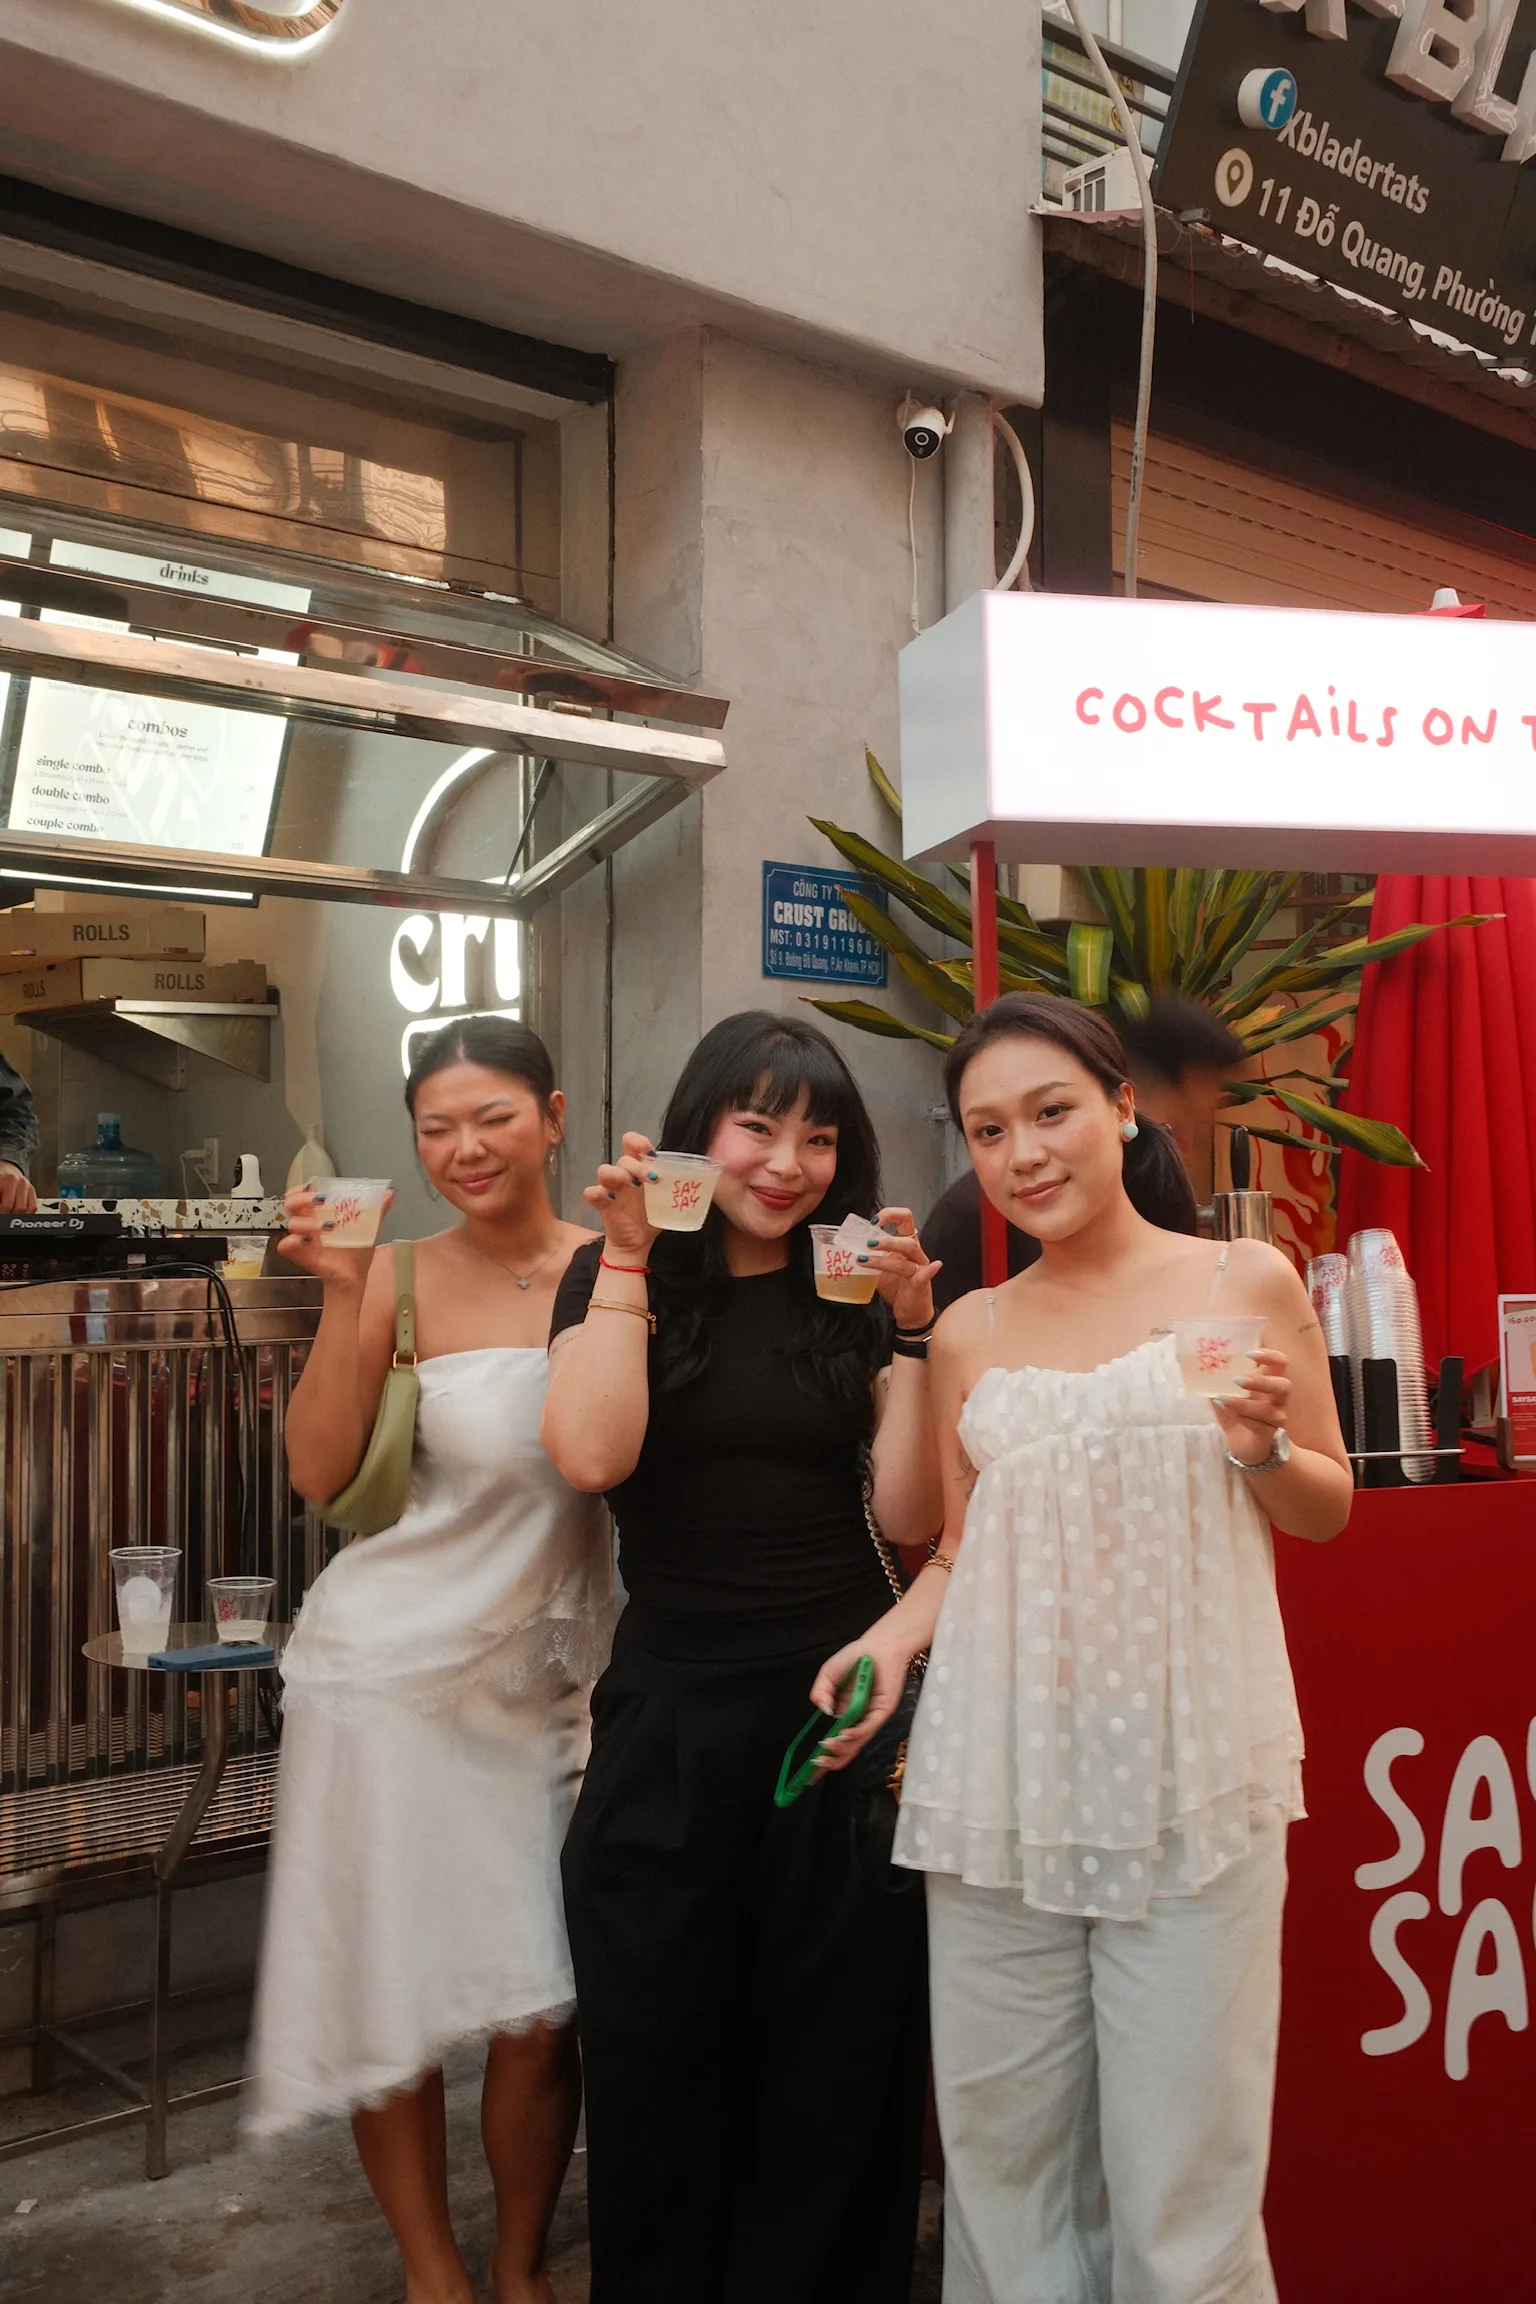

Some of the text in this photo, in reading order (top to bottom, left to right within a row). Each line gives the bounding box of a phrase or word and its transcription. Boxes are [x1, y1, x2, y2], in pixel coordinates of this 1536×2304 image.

[1276, 109, 1431, 215] Xbladertats
[1258, 178, 1292, 225] 11
[1294, 196, 1340, 247] Đỗ
[1341, 220, 1427, 301] Quang,
[1431, 265, 1526, 346] Phường
[159, 563, 210, 586] drinks
[127, 717, 189, 739] combos
[1422, 707, 1498, 746] ON
[36, 754, 70, 771] single
[31, 784, 70, 801] double
[26, 816, 64, 830] couple
[793, 879, 818, 900] CÔNG
[822, 885, 835, 900] TY
[773, 900, 825, 929] CRUST
[72, 924, 131, 942] ROLLS
[770, 928, 793, 946] MST:
[22, 980, 47, 999] ROLLS
[154, 973, 206, 991] ROLLS
[672, 1180, 702, 1197] SAY
[671, 1195, 701, 1212] SAY
[826, 1249, 853, 1267] SAY
[826, 1265, 854, 1282] SAY
[217, 1596, 235, 1609] SAY
[218, 1609, 239, 1623] SAY
[1354, 1714, 1536, 1917] SA
[1360, 1890, 1536, 2082] SA
